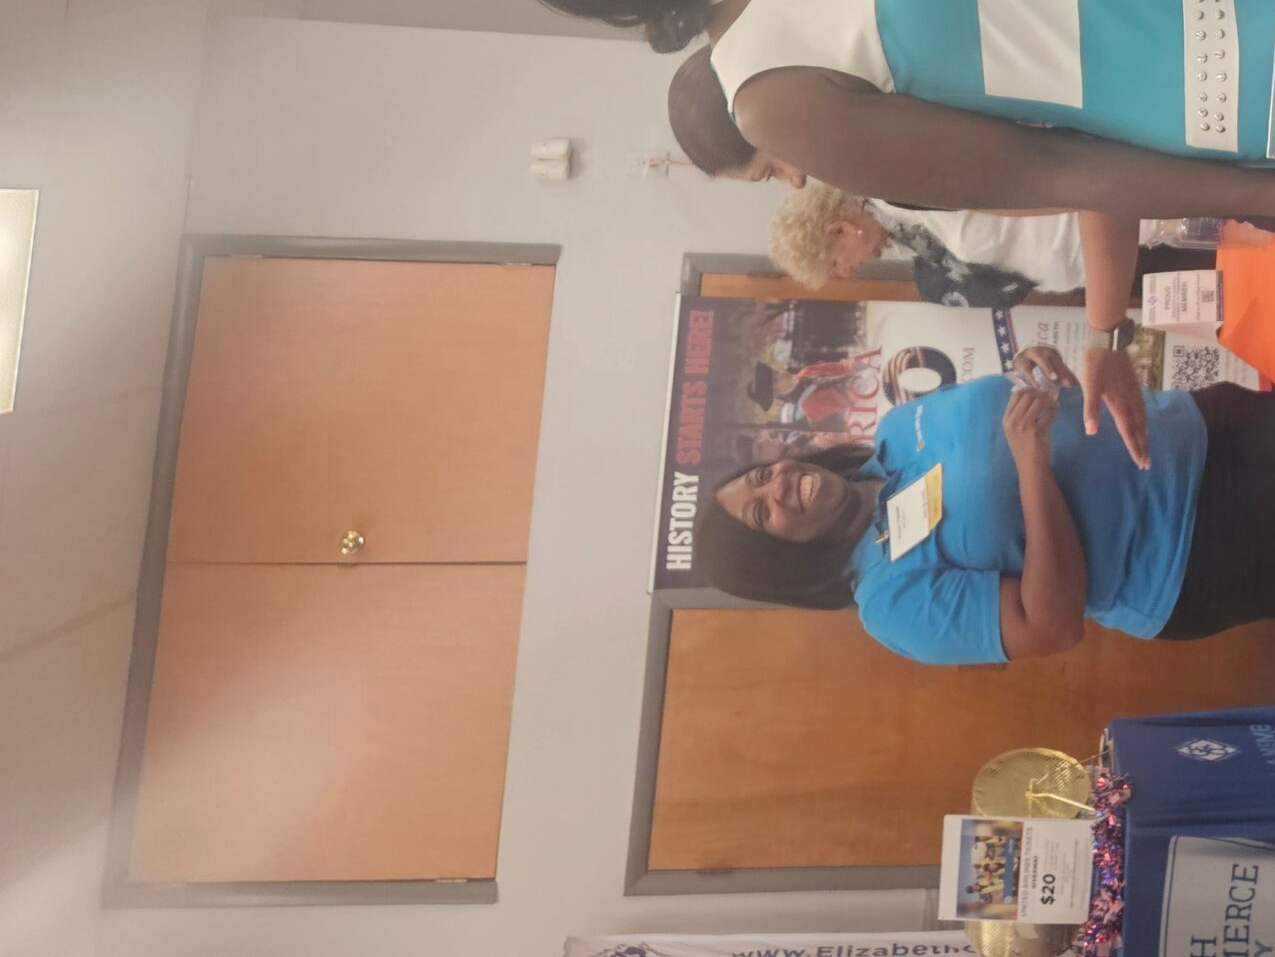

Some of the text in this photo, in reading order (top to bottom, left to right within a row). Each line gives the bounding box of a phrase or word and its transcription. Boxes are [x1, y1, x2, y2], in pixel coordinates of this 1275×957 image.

[666, 310, 714, 570] HISTORY STARTS HERE!
[1025, 827, 1033, 855] TICKETS
[1023, 858, 1031, 888] AIRLINES
[1040, 874, 1056, 905] $20
[1255, 940, 1273, 957] Y
